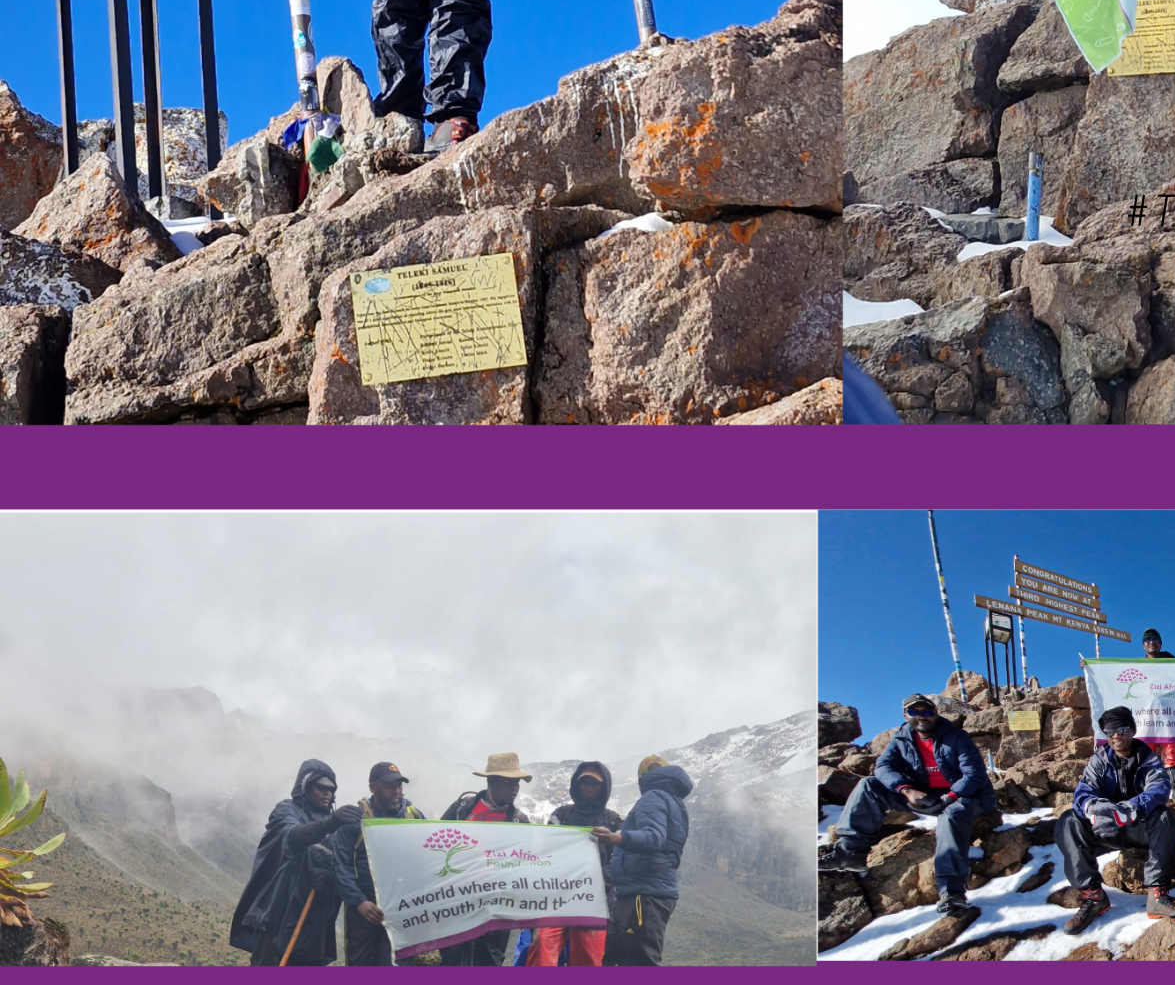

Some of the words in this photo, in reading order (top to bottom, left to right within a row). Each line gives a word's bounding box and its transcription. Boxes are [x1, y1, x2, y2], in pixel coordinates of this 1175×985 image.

[1021, 577, 1038, 589] YOU
[1042, 584, 1059, 596] ARE
[1062, 590, 1079, 601] NOW
[1082, 596, 1092, 605] AT
[1022, 565, 1093, 594] CONGRATULATIONS
[986, 599, 1023, 615] LENANA
[1026, 609, 1049, 621] PEAK
[1052, 615, 1063, 624] MT
[1066, 618, 1090, 631] KENYA
[1015, 589, 1040, 602] THIRD
[1045, 598, 1078, 613] HIGHEST
[1081, 609, 1101, 620] PEAK
[1134, 707, 1160, 716] where
[1161, 707, 1172, 715] all
[1143, 720, 1164, 728] learn
[398, 899, 411, 912] A
[412, 885, 455, 907] world
[458, 880, 507, 897] where
[511, 877, 528, 890] all
[533, 876, 593, 891] children
[402, 910, 430, 929] and
[432, 901, 475, 923] youth
[519, 897, 548, 911] and
